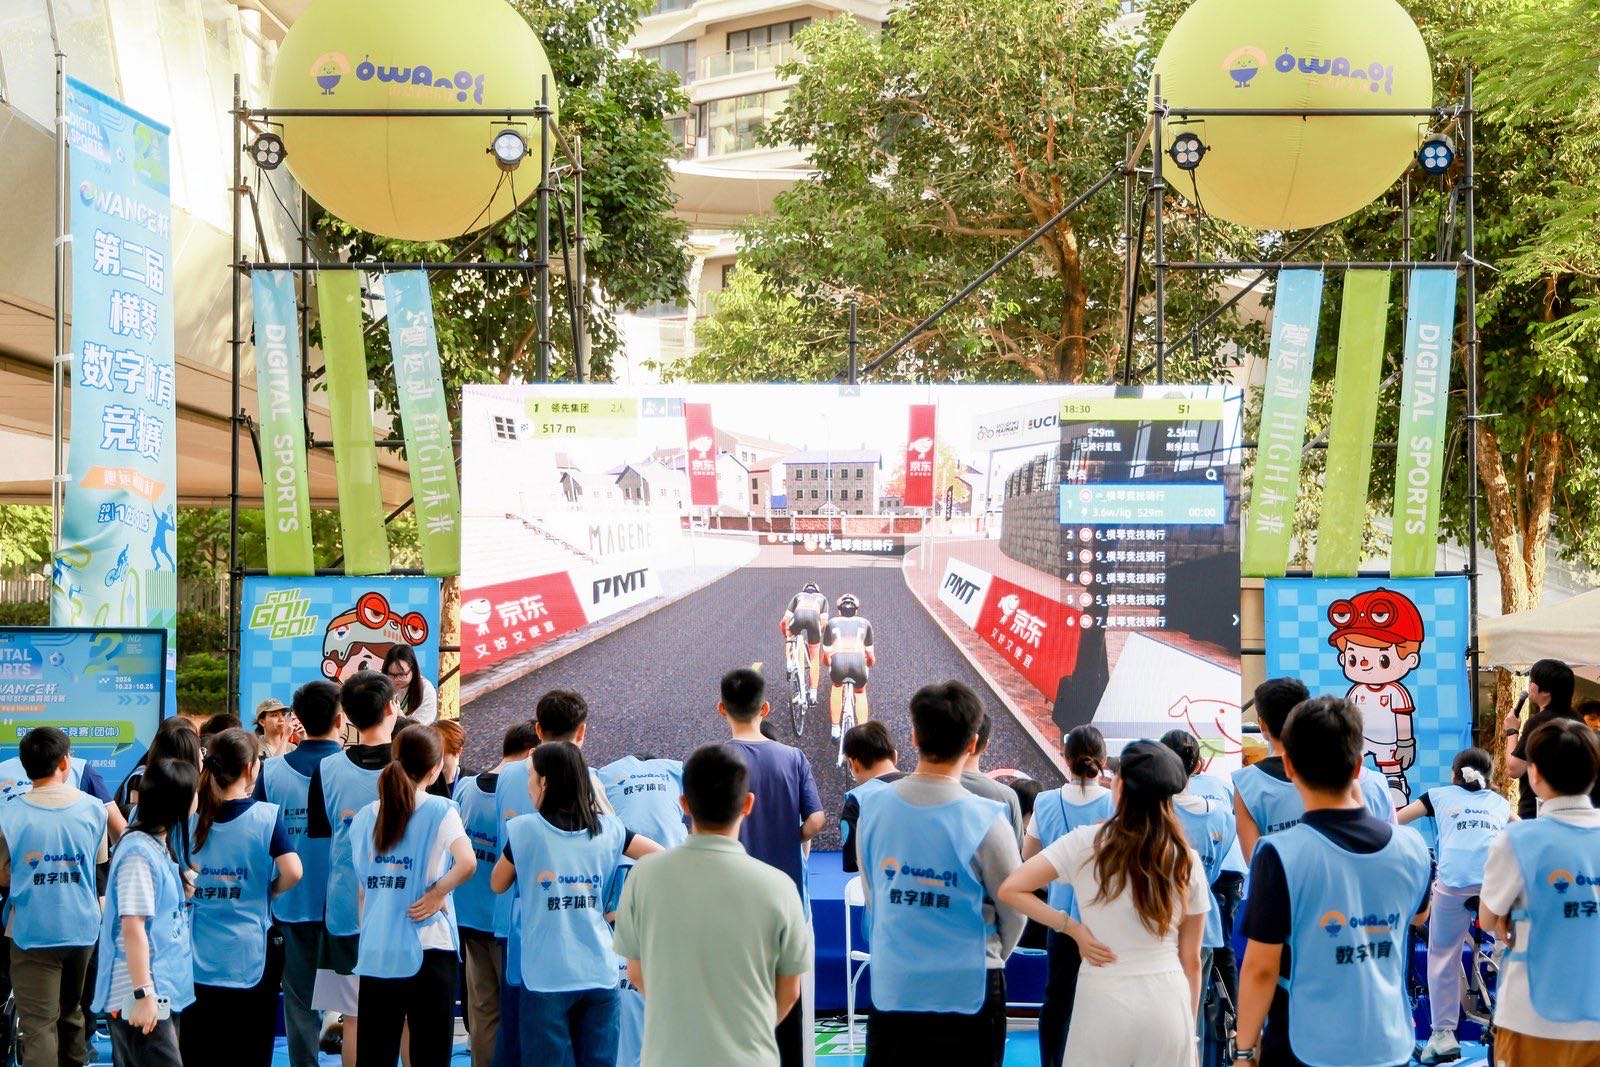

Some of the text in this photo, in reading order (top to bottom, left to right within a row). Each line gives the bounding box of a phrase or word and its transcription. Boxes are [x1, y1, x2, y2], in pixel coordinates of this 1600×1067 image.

[70, 113, 104, 140] DIGITAL
[70, 131, 104, 153] SPORTS
[93, 228, 164, 295] 第二届
[109, 289, 158, 344] 横琴
[551, 403, 590, 413] 领先集团
[1064, 405, 1091, 414] 18:30
[265, 324, 299, 533] DIGITAL SPORTS
[542, 423, 576, 434] 517 m
[1034, 415, 1057, 429] UCI
[1405, 323, 1440, 536] DIGITAL SPORTS
[100, 404, 164, 463] 竞赛
[1087, 428, 1115, 438] 529m
[1166, 428, 1198, 438] 2.5km
[692, 460, 715, 471] 京东
[910, 461, 932, 472] 京东
[1137, 508, 1164, 518] 529m
[1188, 508, 1216, 518] 00:00
[1066, 531, 1075, 539] 2
[1066, 553, 1075, 561] 3
[1066, 574, 1075, 582] 4
[592, 568, 649, 605] PMT
[944, 572, 981, 605] PMT
[1066, 596, 1075, 604] 5
[249, 598, 311, 629] GO!!
[495, 594, 549, 628] 京东
[269, 615, 319, 640] GO!!
[1010, 608, 1047, 648] 京东
[1066, 617, 1075, 625] 6
[474, 620, 556, 659] 又好又便宜
[990, 627, 1034, 669] 又好又便宜
[623, 782, 667, 796] 数字体育
[33, 872, 81, 886] 数字体育
[547, 895, 598, 911] 数字体育
[890, 888, 950, 909] 数字体育
